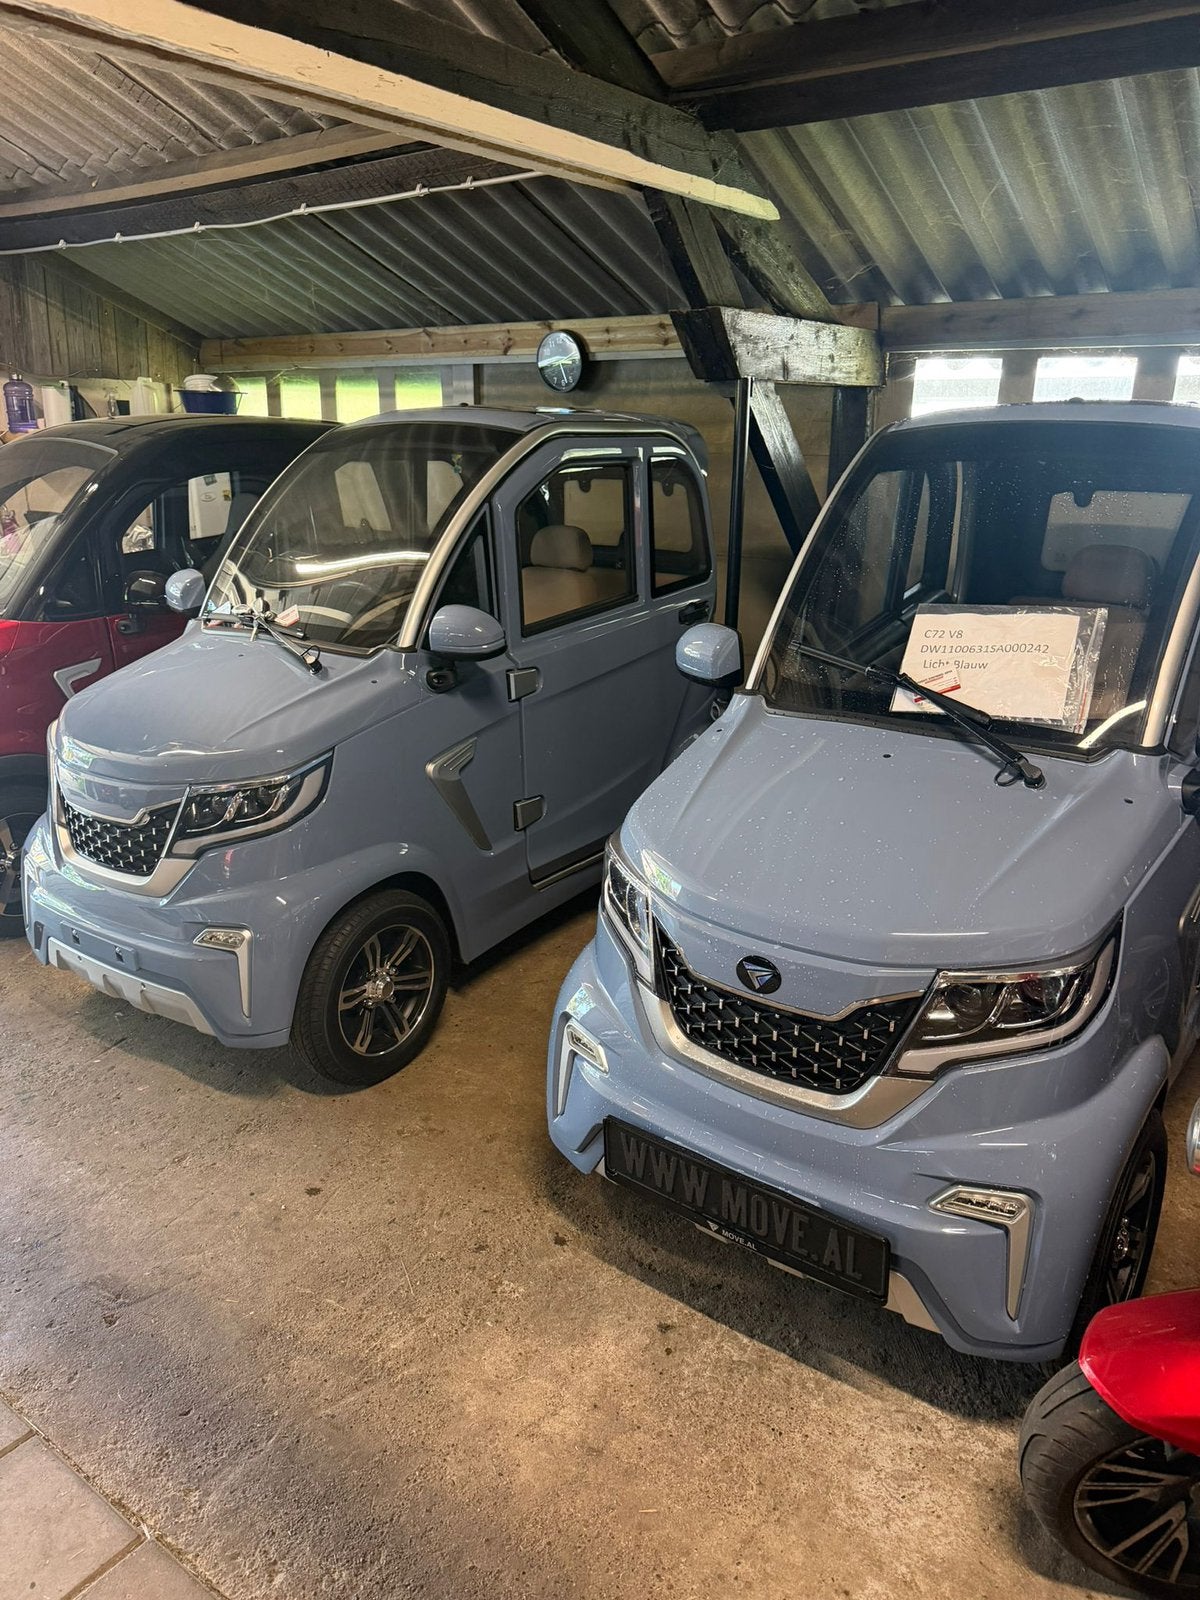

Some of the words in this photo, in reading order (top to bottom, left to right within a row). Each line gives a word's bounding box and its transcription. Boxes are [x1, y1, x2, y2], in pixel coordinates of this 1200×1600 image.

[924, 629, 946, 639] C72
[949, 629, 964, 639] V8
[953, 660, 989, 670] Blauw
[721, 1229, 758, 1251] MOVE.AL
